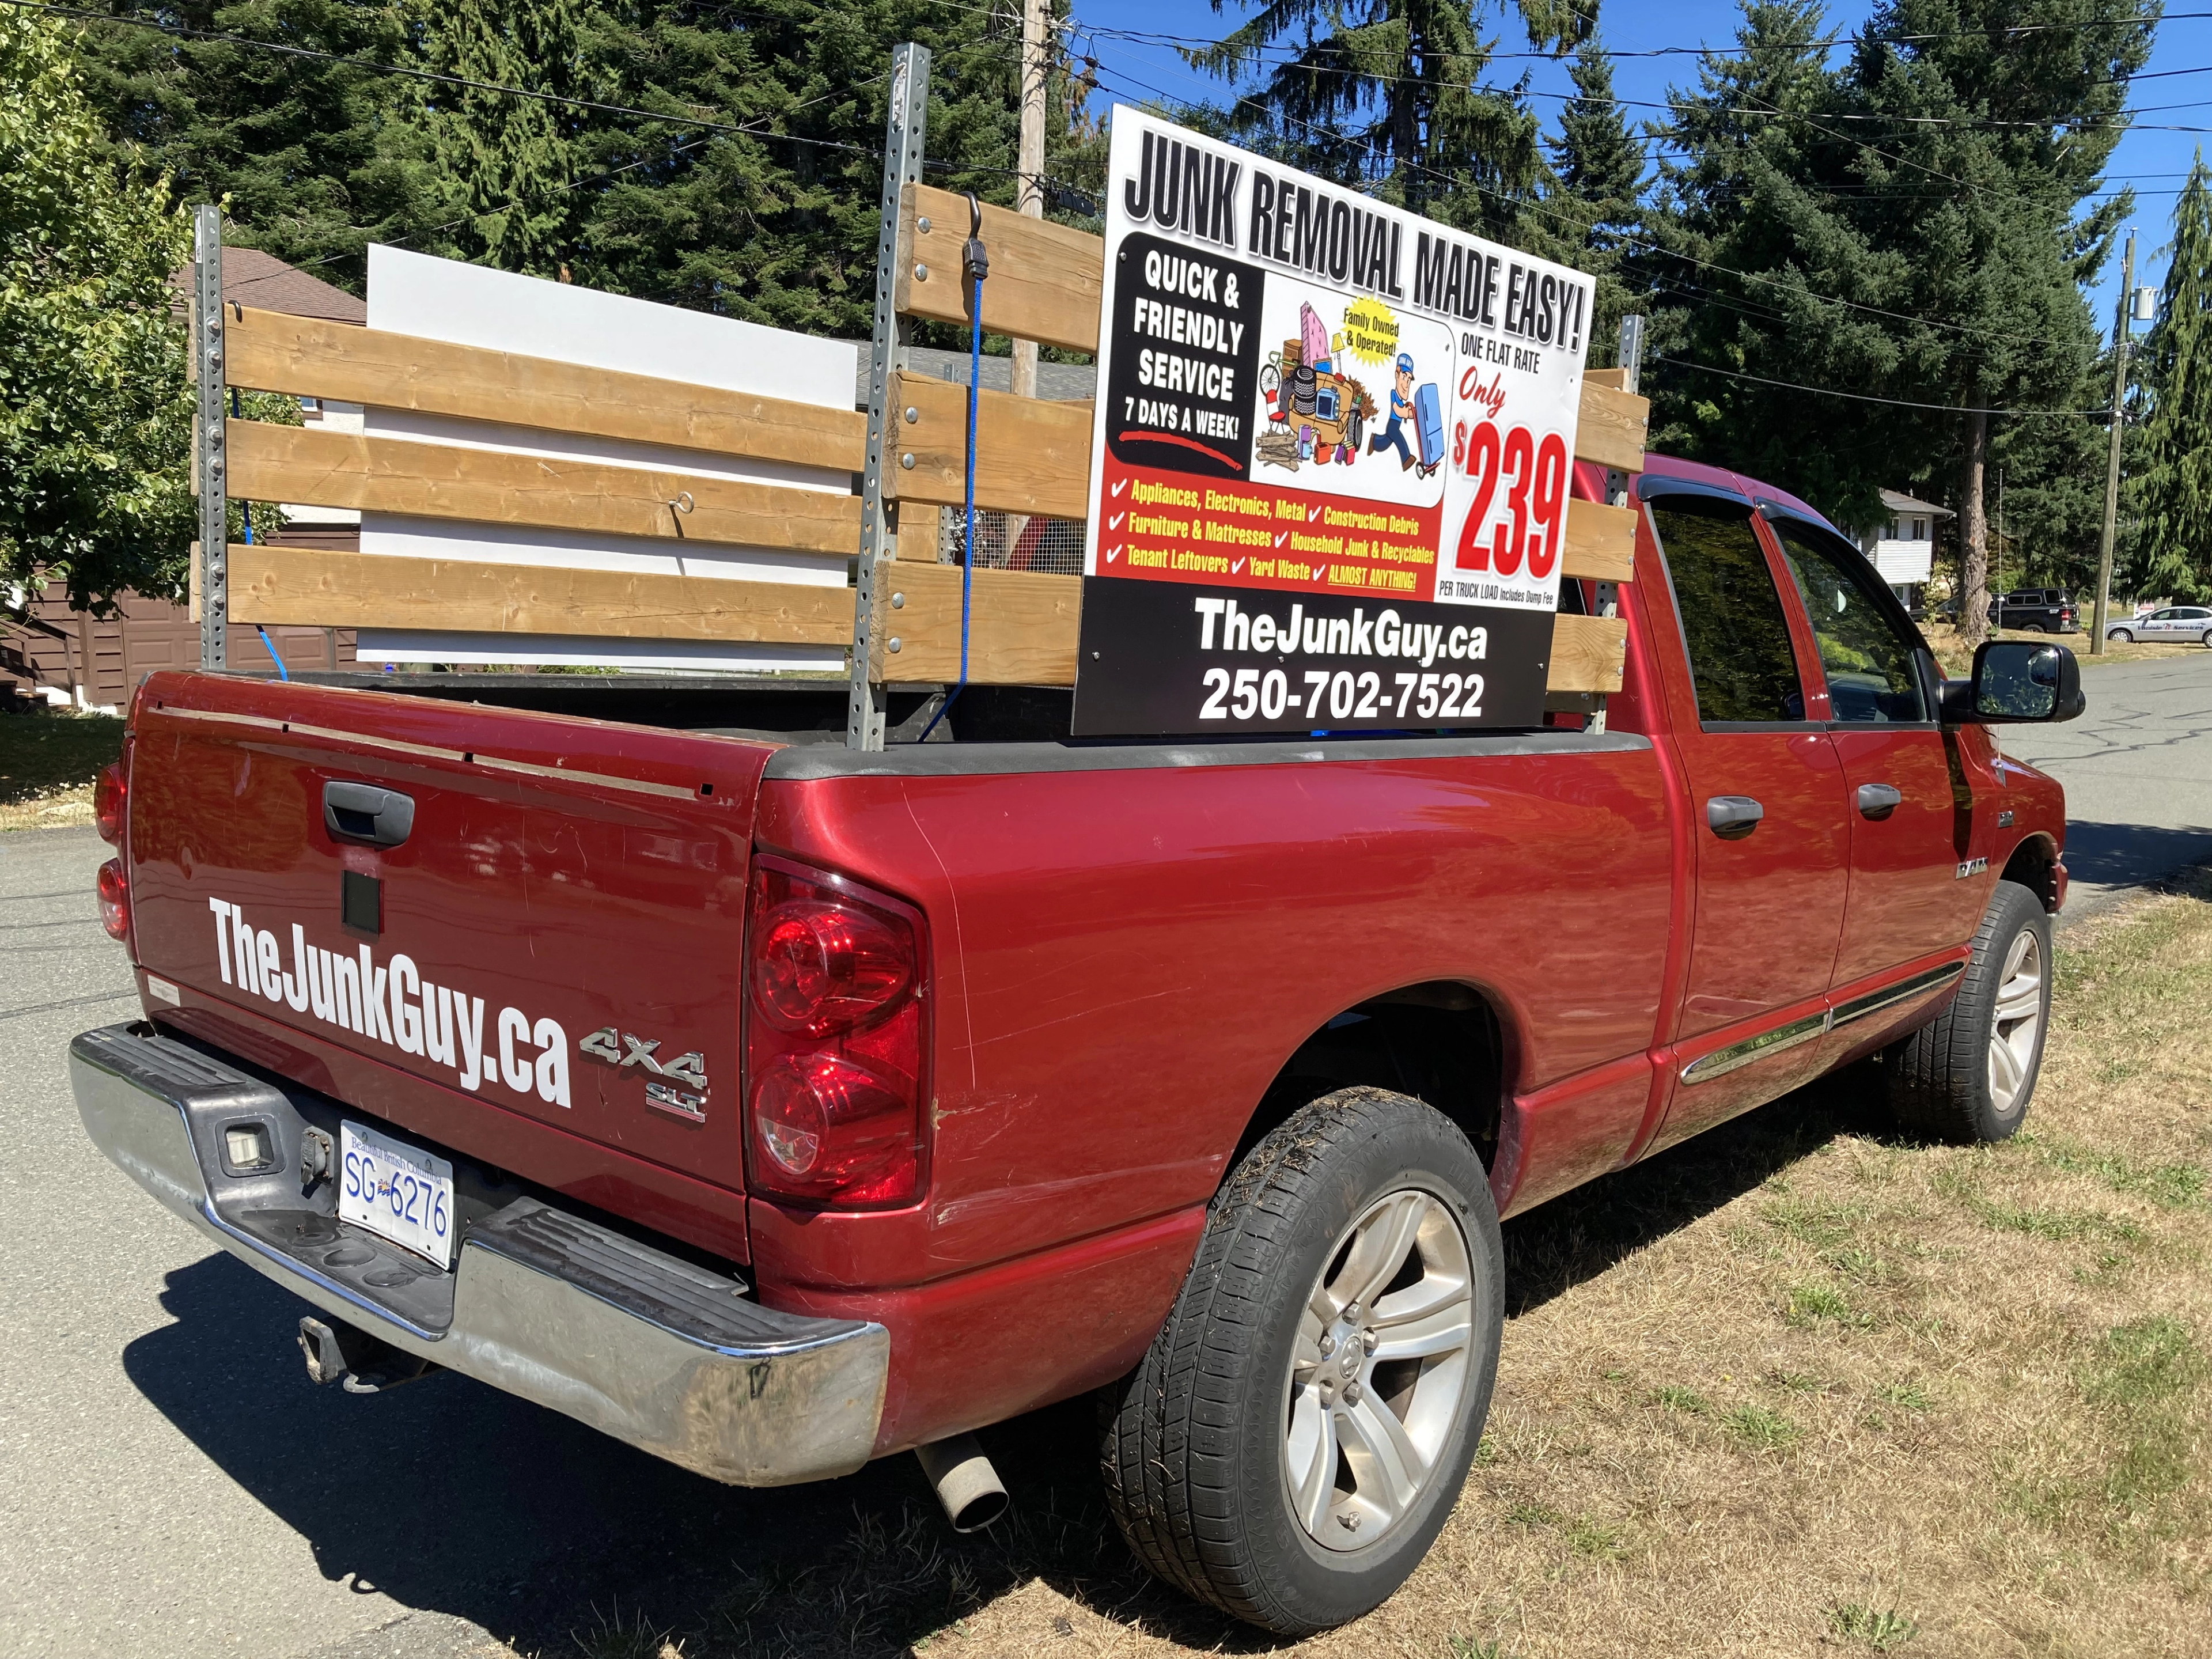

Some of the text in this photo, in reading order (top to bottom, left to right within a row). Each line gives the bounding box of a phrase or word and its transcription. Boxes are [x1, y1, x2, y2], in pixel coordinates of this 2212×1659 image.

[1124, 130, 1584, 352] JUNK REMOVAL MADE EASY!
[1145, 250, 1240, 309] QUICK &
[1134, 297, 1244, 355] FRIENDLY
[1343, 308, 1399, 338] Family Owned
[1347, 330, 1396, 357] & Operated!
[1139, 349, 1234, 402] SERVICE
[1461, 332, 1540, 374] ONE FLAT RATE
[1125, 397, 1239, 440] 7 DAYS A WEEK!
[1459, 365, 1506, 419] Only
[1131, 479, 1419, 536] Appliances, Electronics, Metal Construction Debris
[1128, 512, 1434, 565] Furniture & Mattresses Household Junk & Recyclables
[1127, 544, 1416, 589] Tenant Leftovers Yard Waste ALMOST ANYTHING!
[1439, 580, 1553, 606] PER TRUCK LOAD Includes Dump Fee
[1195, 597, 1487, 667] TheJunkGuy.ca
[1199, 668, 1484, 720] 250-702-7522
[209, 896, 571, 1109] TheJunkGuy.ca
[646, 1082, 707, 1115] SLT
[351, 1137, 442, 1185] Beautiful British Columbia
[346, 1152, 446, 1237] SG 6276
